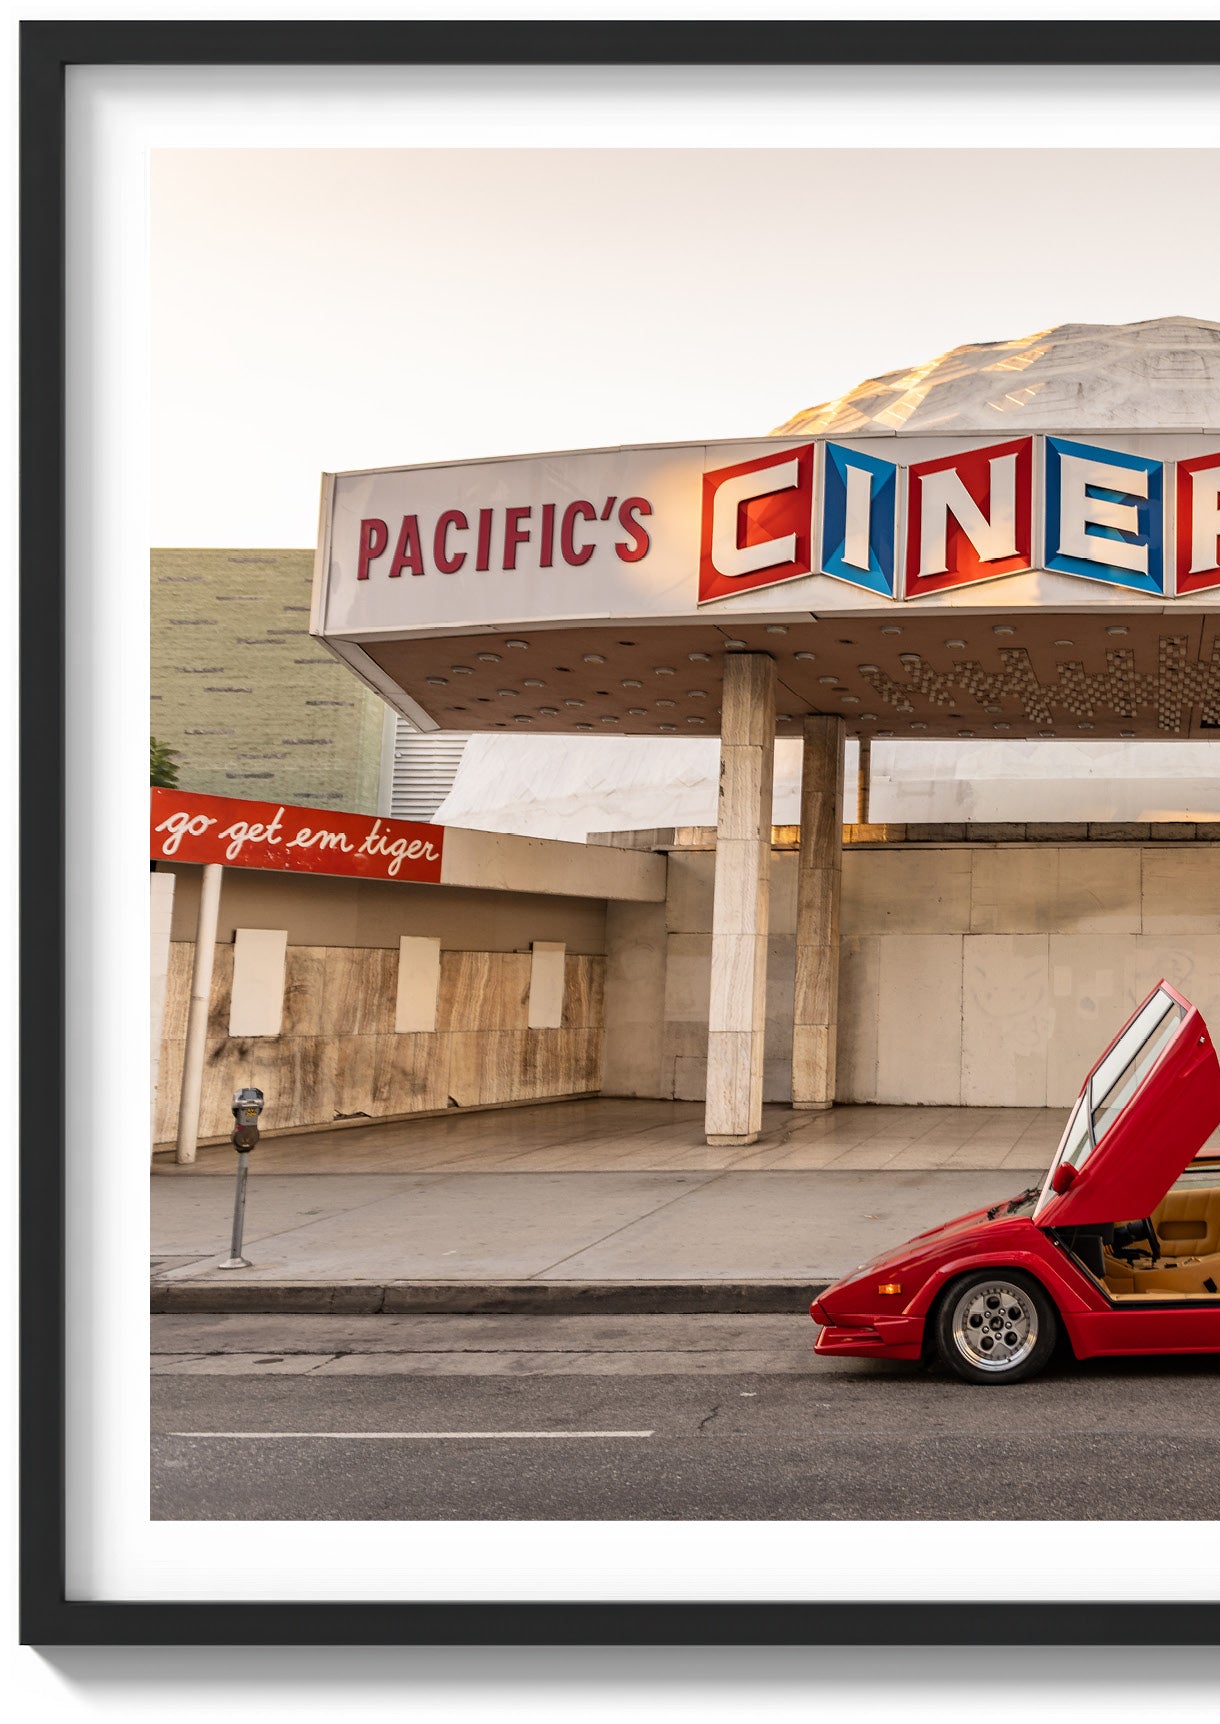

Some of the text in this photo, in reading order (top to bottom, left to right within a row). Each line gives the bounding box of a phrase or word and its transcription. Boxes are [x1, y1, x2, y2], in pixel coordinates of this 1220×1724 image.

[356, 495, 654, 581] PACIFIC'S
[155, 806, 440, 876] go get em tiger
